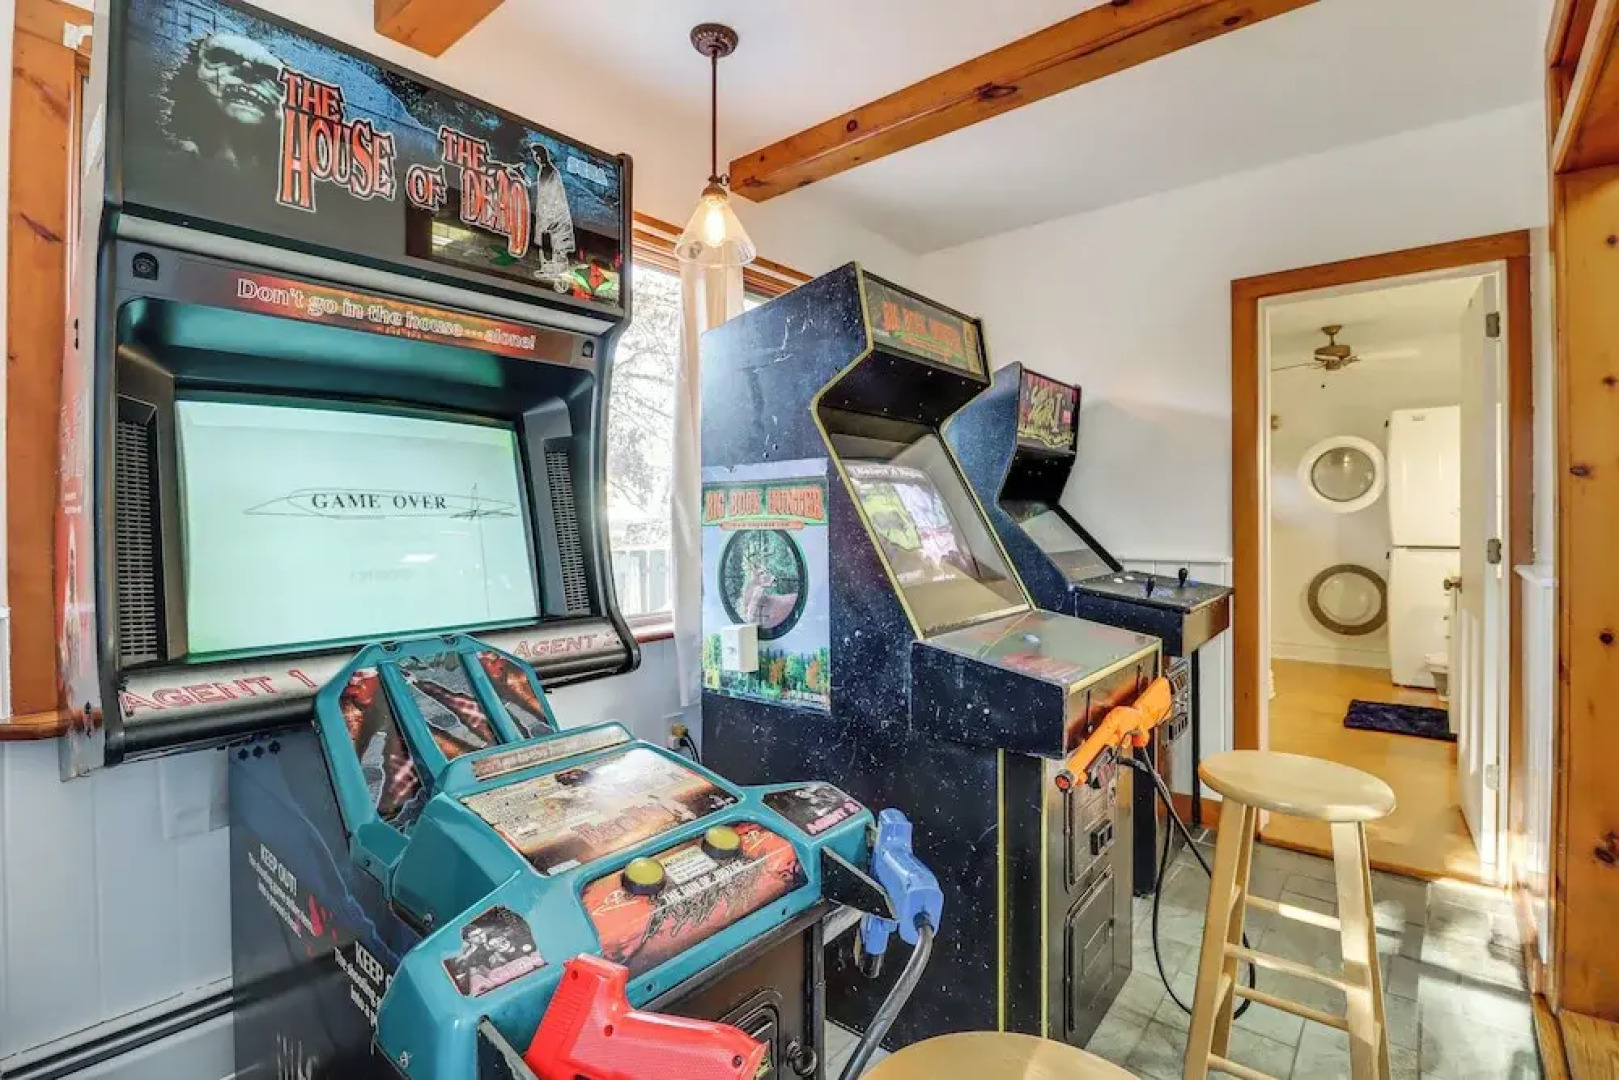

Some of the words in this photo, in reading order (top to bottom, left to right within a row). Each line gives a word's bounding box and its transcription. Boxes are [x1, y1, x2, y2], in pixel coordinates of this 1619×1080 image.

[280, 69, 345, 121] THE
[278, 107, 396, 211] HOUSE
[439, 126, 490, 170] THE
[406, 164, 447, 211] OF
[460, 167, 529, 257] DEAD
[237, 277, 304, 309] Don't
[308, 295, 338, 316] go
[342, 297, 364, 319] in
[367, 304, 402, 327] the
[311, 493, 381, 509] GAME
[392, 494, 446, 509] OVER
[514, 634, 598, 657] AGENT
[118, 675, 277, 717] AGENT
[288, 669, 318, 689] 1
[355, 941, 385, 986] KEEP
